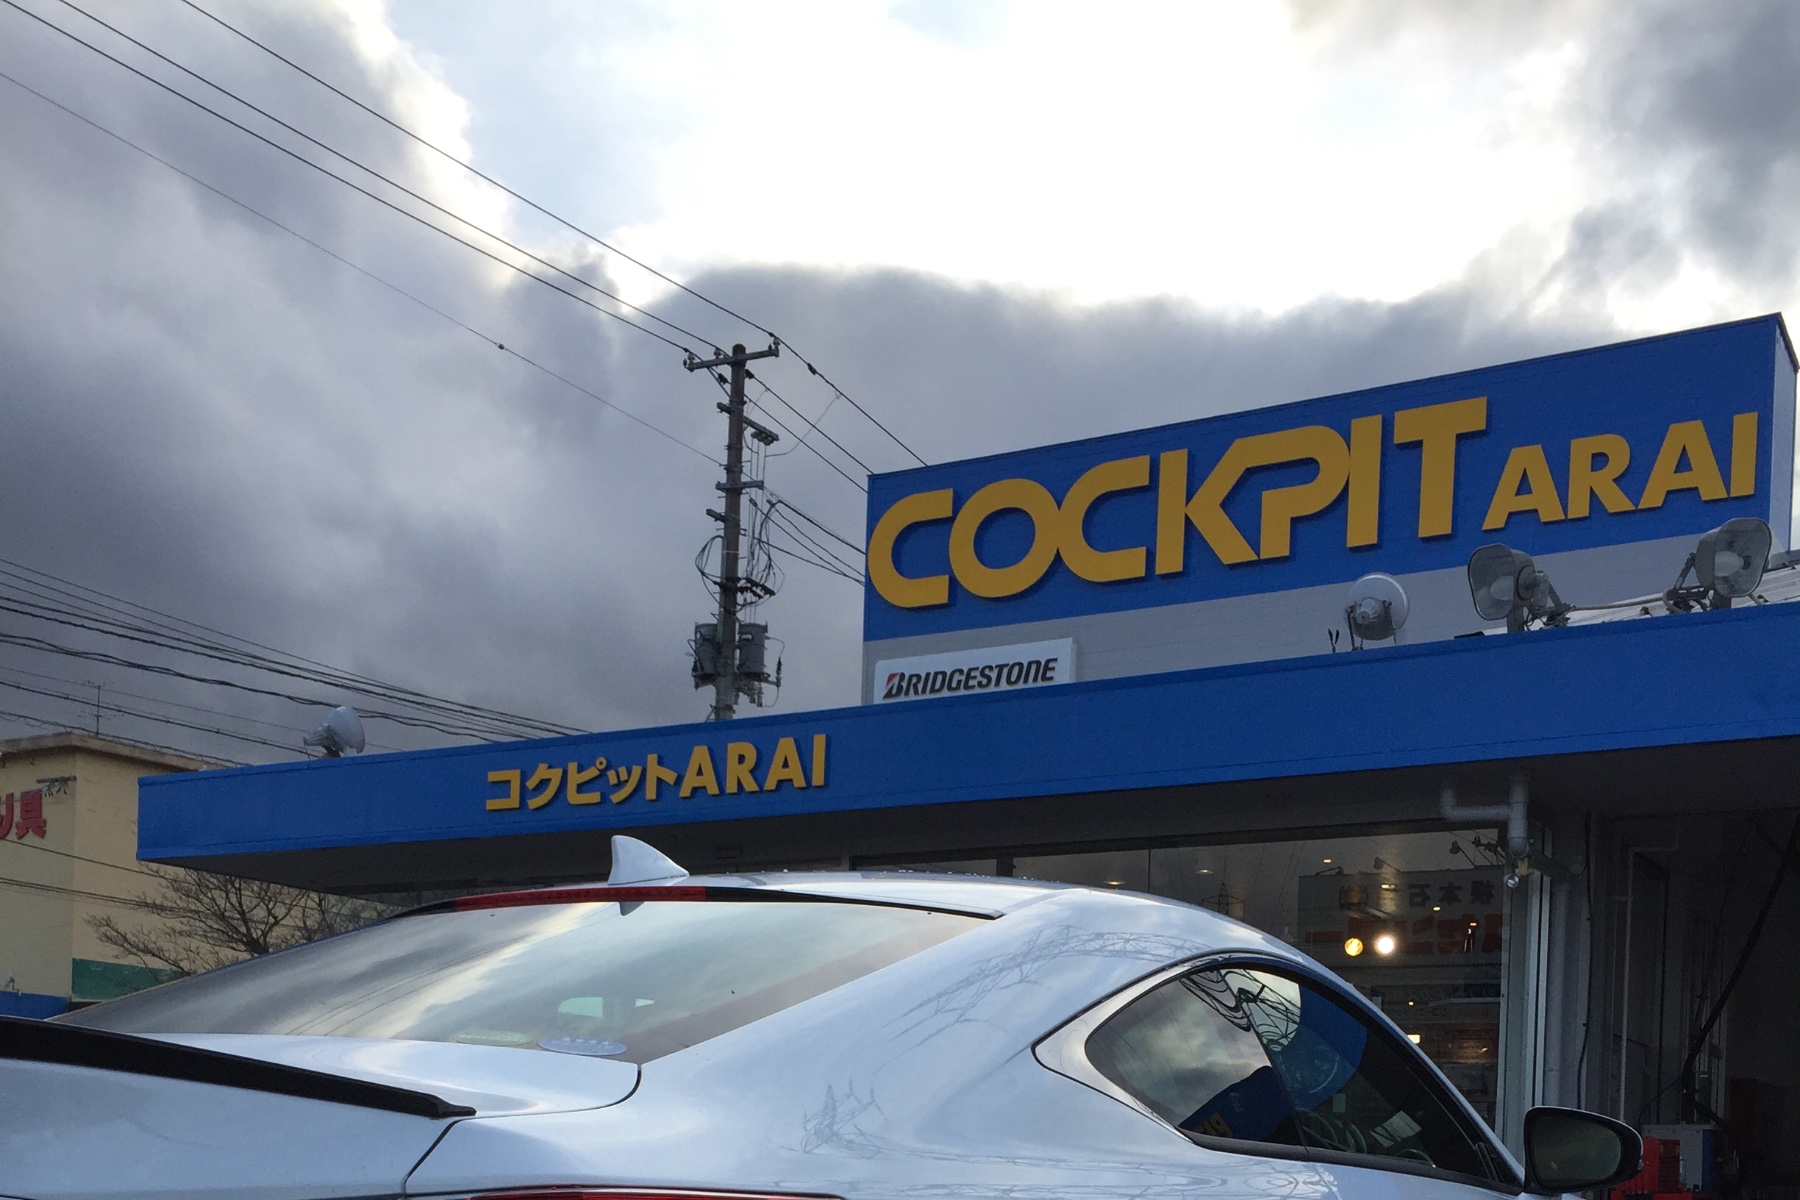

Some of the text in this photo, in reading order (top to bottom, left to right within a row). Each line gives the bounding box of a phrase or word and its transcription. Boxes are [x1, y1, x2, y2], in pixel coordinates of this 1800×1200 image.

[868, 396, 1759, 609] COCKPIT ARAI
[883, 658, 1058, 700] BRIDGESTONE
